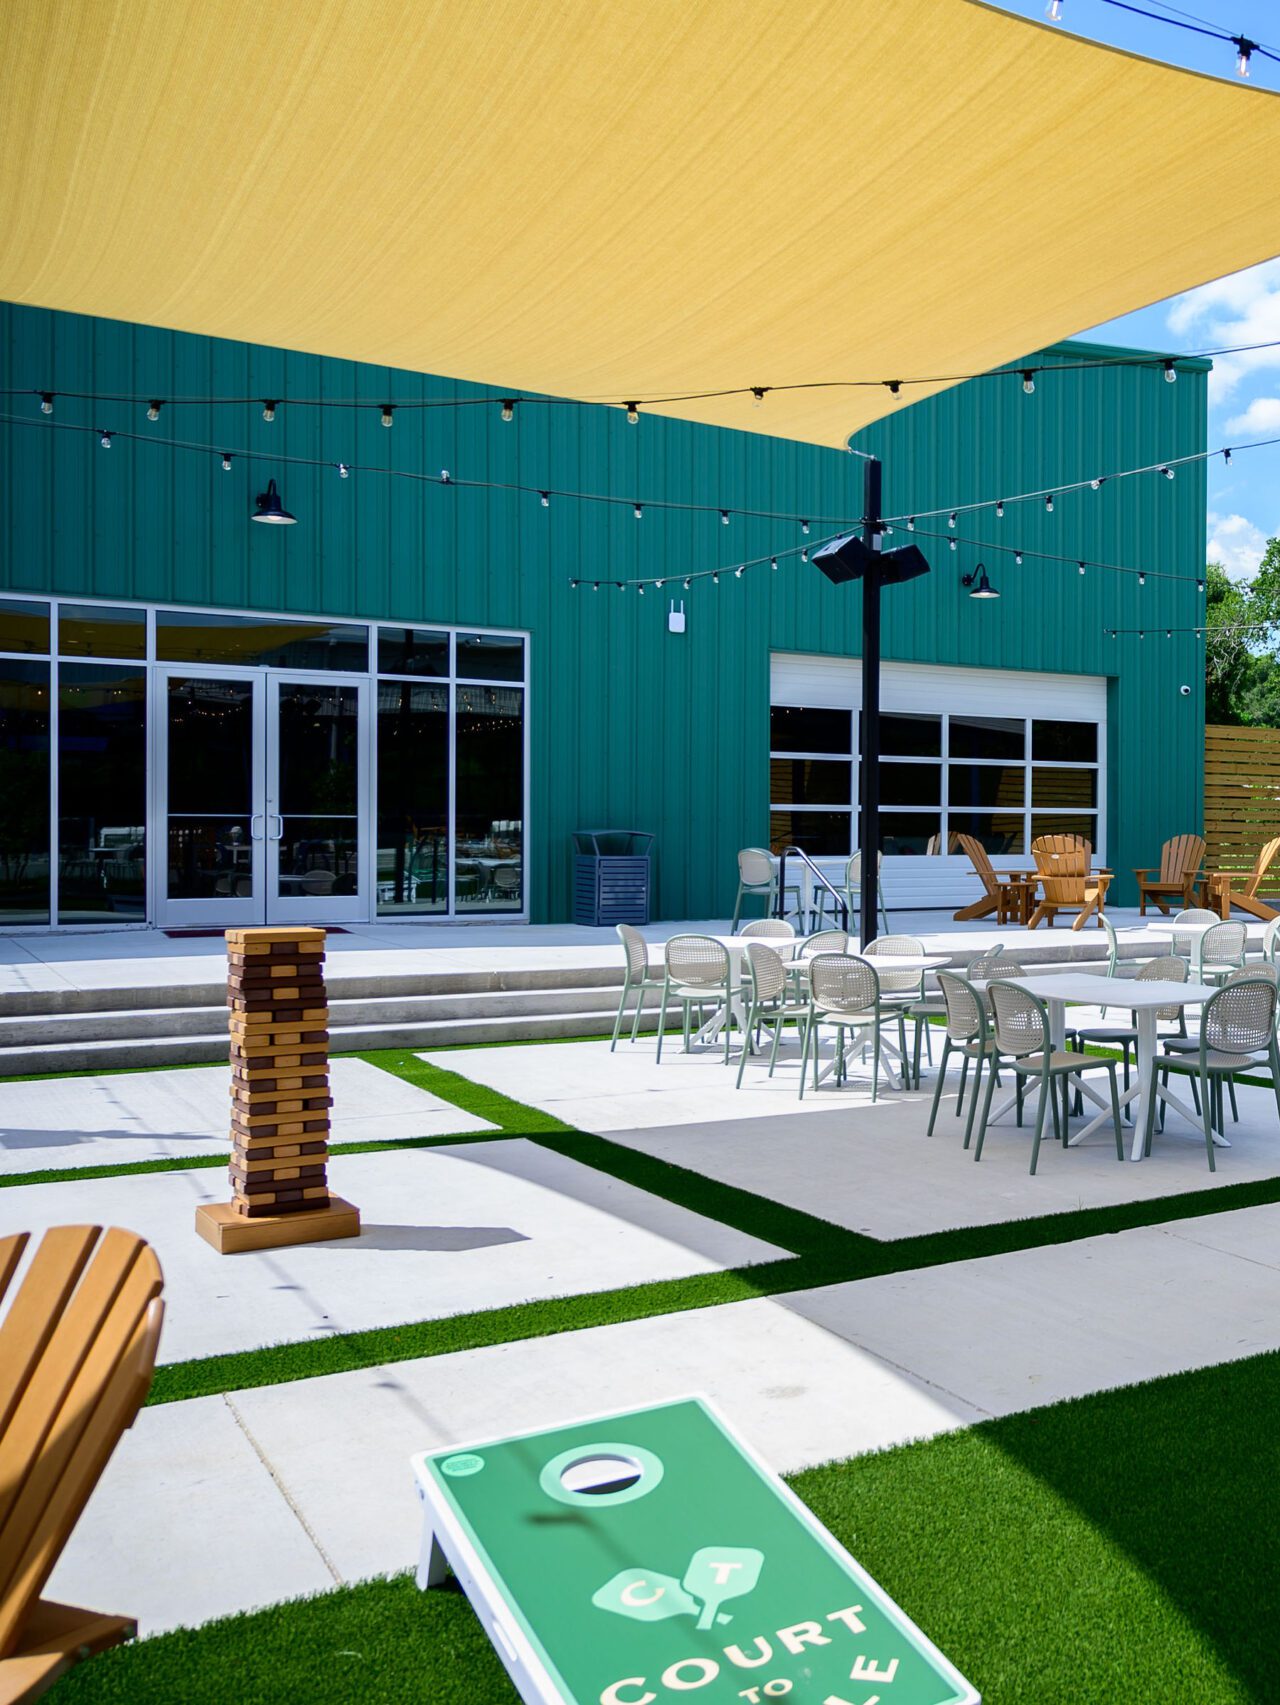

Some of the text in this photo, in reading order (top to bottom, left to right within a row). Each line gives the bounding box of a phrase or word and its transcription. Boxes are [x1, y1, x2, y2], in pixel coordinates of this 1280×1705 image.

[620, 1562, 743, 1607] C T
[600, 1605, 867, 1705] COURT
[738, 1678, 793, 1704] TO
